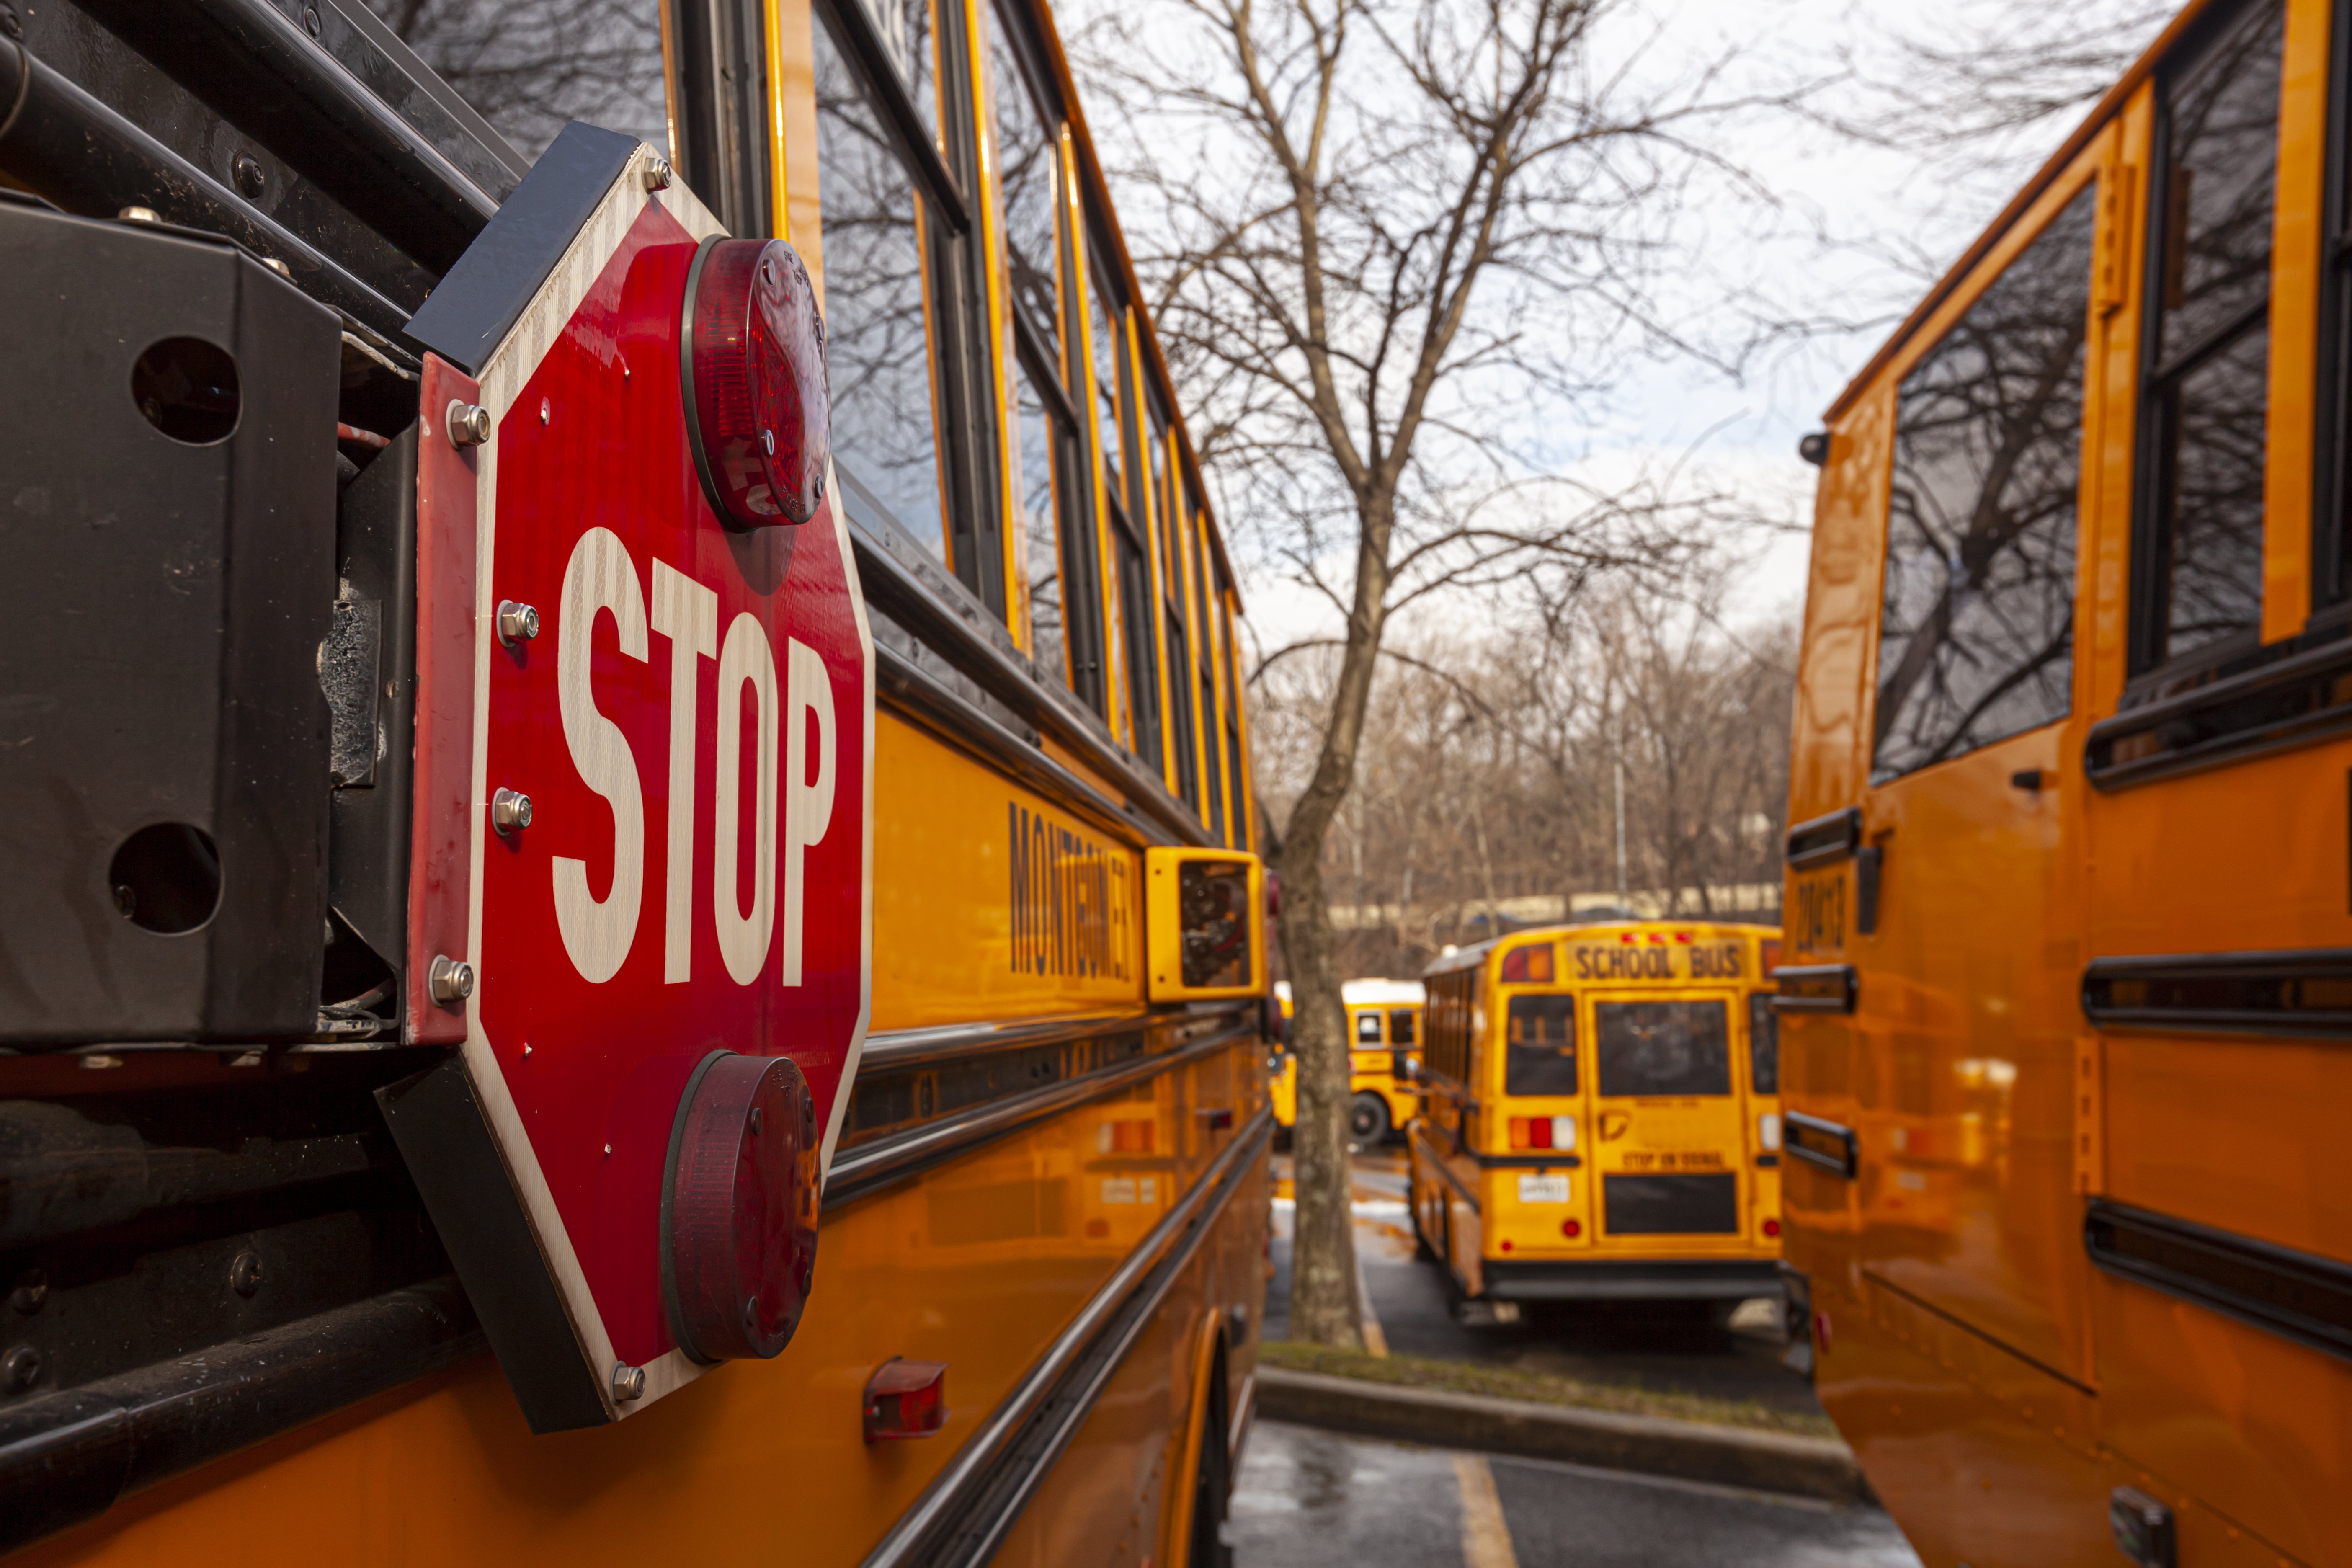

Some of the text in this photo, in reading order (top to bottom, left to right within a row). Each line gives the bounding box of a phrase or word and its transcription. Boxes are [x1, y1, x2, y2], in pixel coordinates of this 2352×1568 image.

[552, 526, 836, 987] STOP
[1576, 944, 1741, 979] SCHOOL BUS
